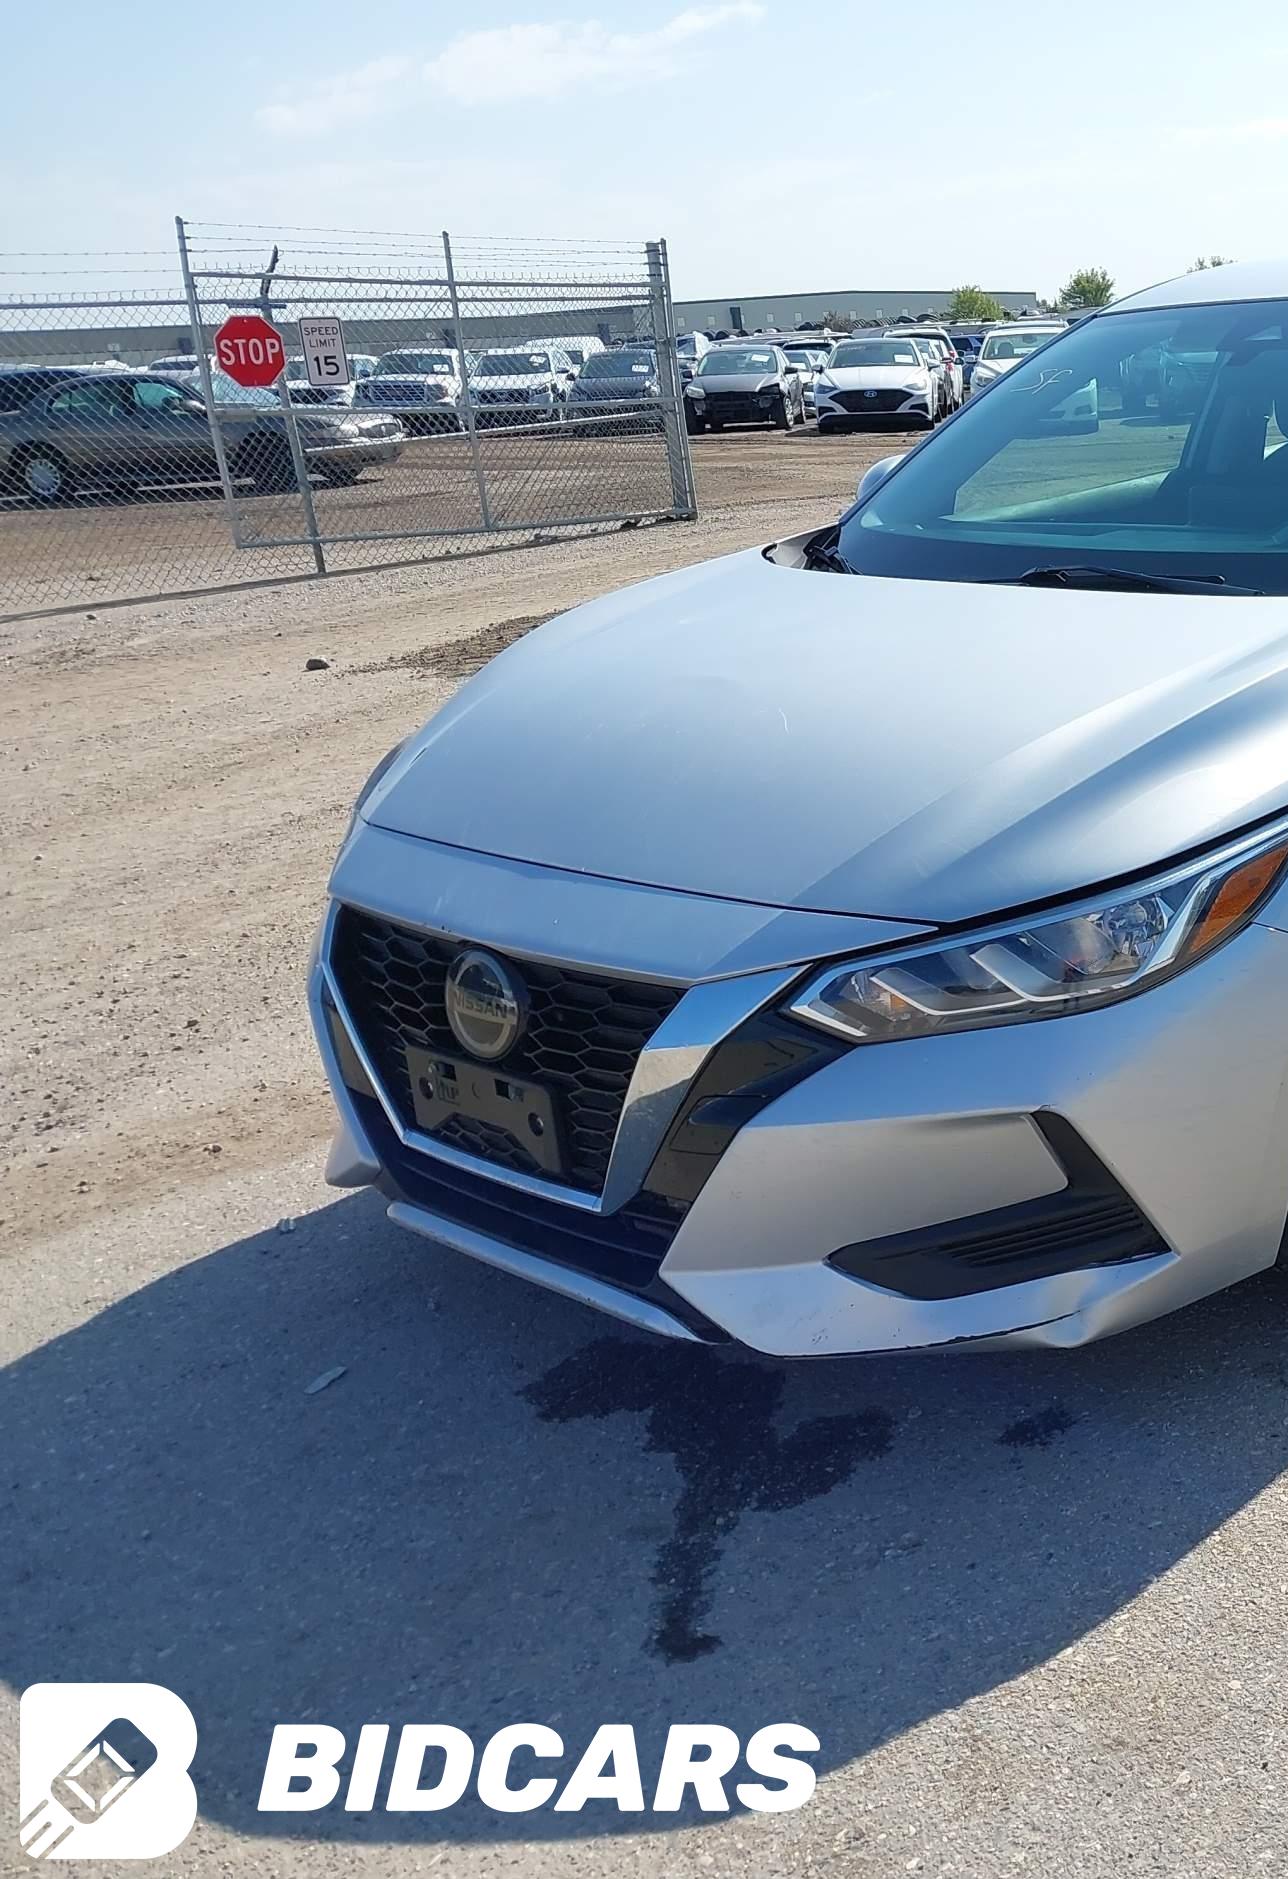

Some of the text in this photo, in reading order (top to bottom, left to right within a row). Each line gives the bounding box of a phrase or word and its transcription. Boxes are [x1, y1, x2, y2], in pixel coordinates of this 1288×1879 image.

[303, 326, 339, 336] SPEED
[219, 338, 280, 366] STOP
[309, 338, 336, 348] LIMIT
[313, 355, 340, 376] 15
[452, 990, 507, 1019] NISSAN
